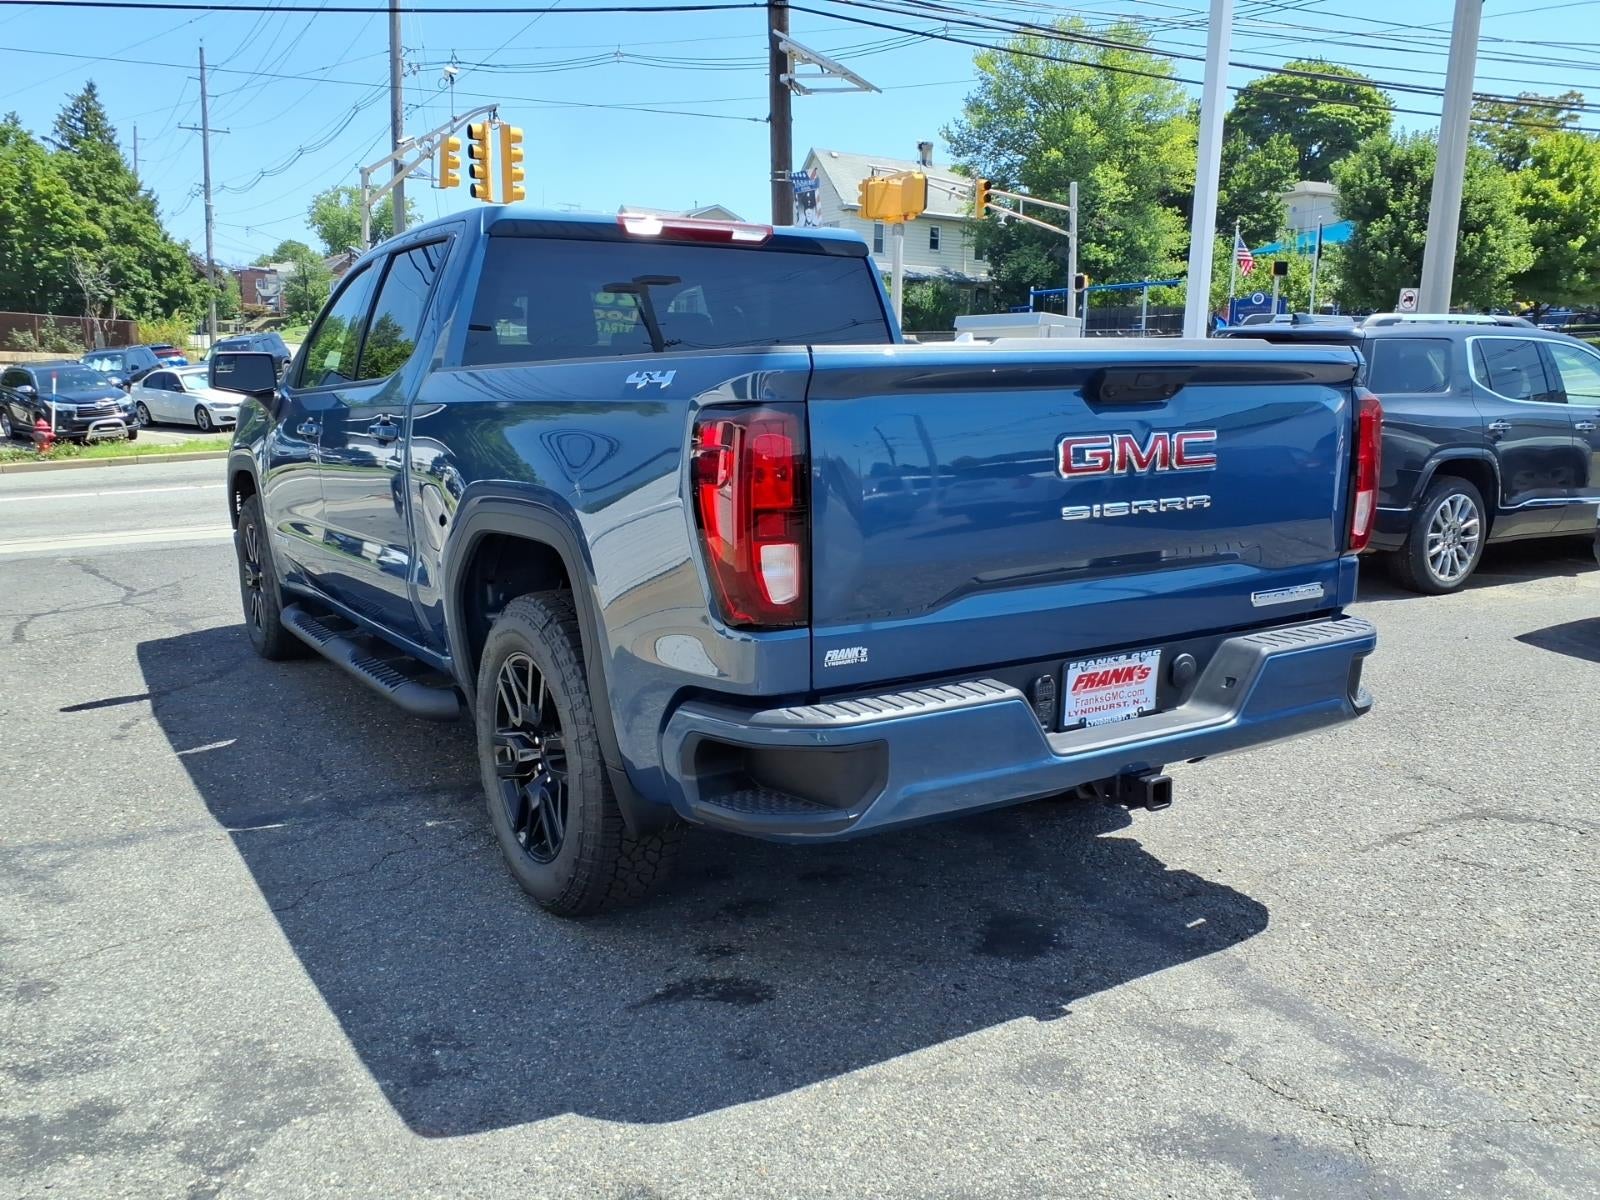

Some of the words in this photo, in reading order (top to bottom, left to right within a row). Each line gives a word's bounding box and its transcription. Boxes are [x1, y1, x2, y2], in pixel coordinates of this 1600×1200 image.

[1059, 430, 1217, 478] GMC
[1062, 495, 1211, 520] SIERRA
[1131, 649, 1161, 661] GMC
[1075, 688, 1145, 707] FranksGMC.com
[1068, 701, 1130, 717] LYNDHURST,
